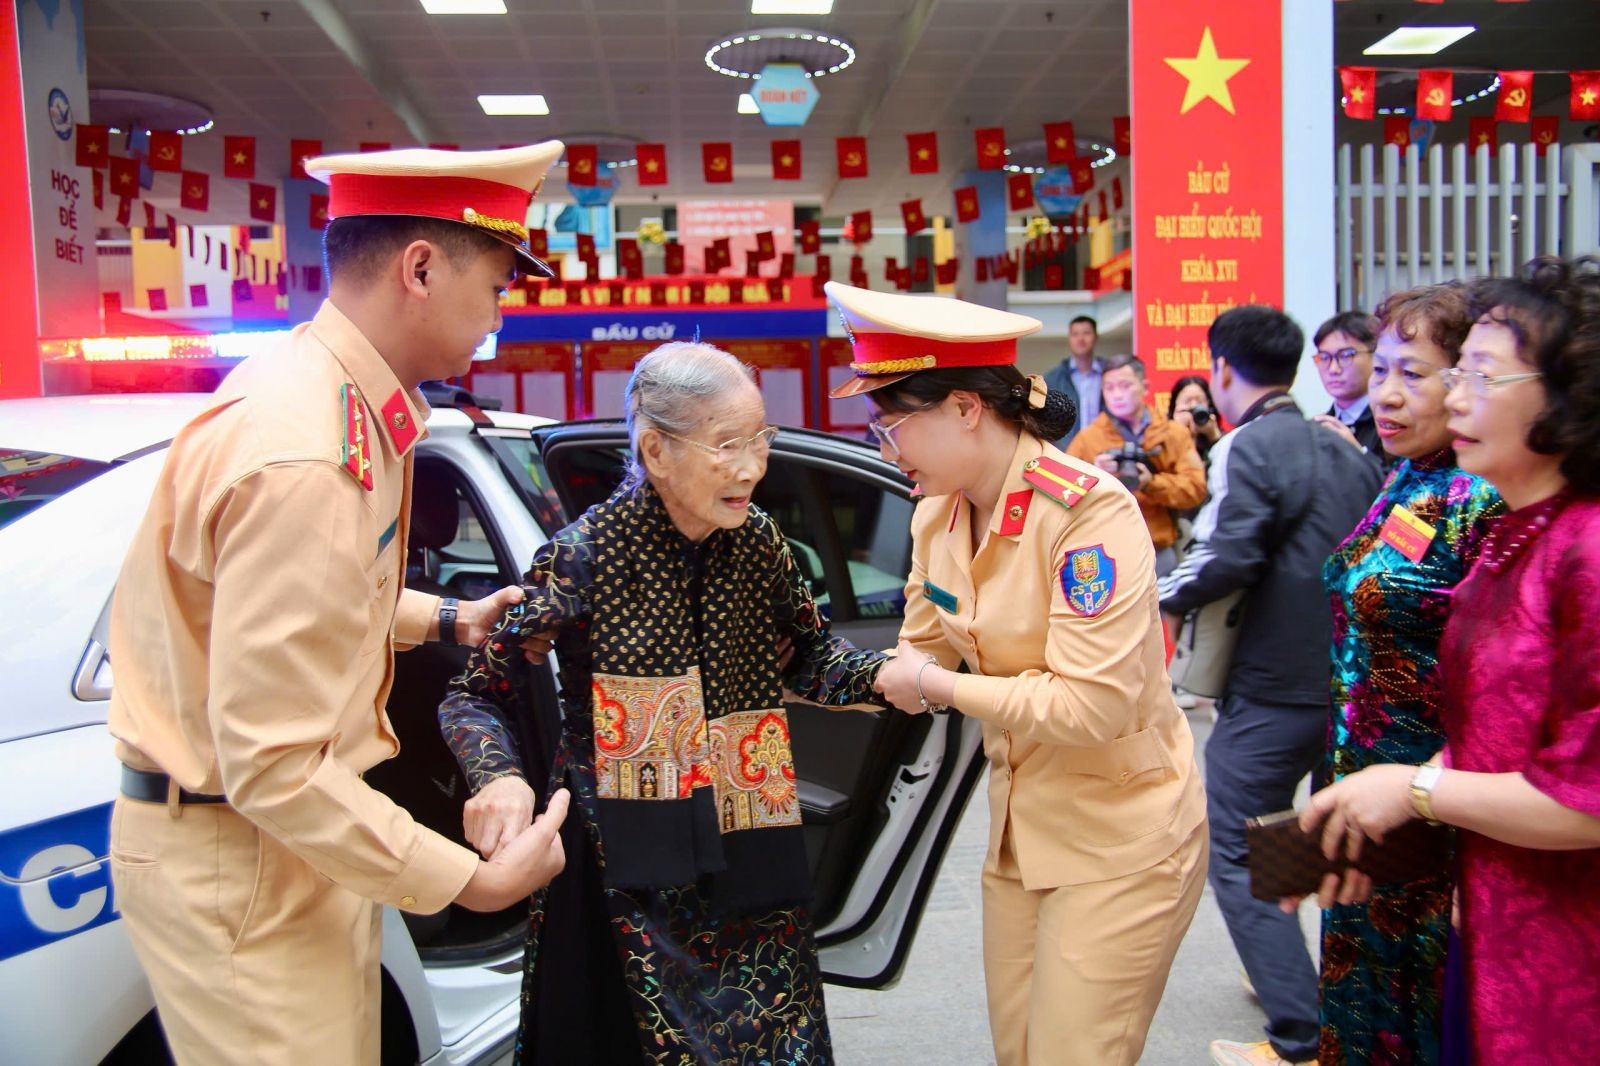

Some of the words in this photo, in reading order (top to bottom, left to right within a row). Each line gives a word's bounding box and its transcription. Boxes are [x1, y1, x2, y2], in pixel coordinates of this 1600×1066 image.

[52, 169, 80, 200] HỌC
[58, 200, 78, 230] ĐỂ
[1155, 215, 1177, 243] ĐẠI
[1179, 202, 1206, 238] BIỂU
[1207, 206, 1240, 239] QUỐC
[1241, 208, 1262, 242] HỘI
[55, 235, 84, 265] BIẾT
[1181, 253, 1214, 282] KHÓA
[1216, 259, 1238, 282] XVI
[1146, 298, 1163, 326] VÀ
[1156, 341, 1190, 370] NHÂN
[1192, 341, 1213, 370] DÂ
[1070, 585, 1085, 596] CS
[1089, 580, 1106, 592] GT
